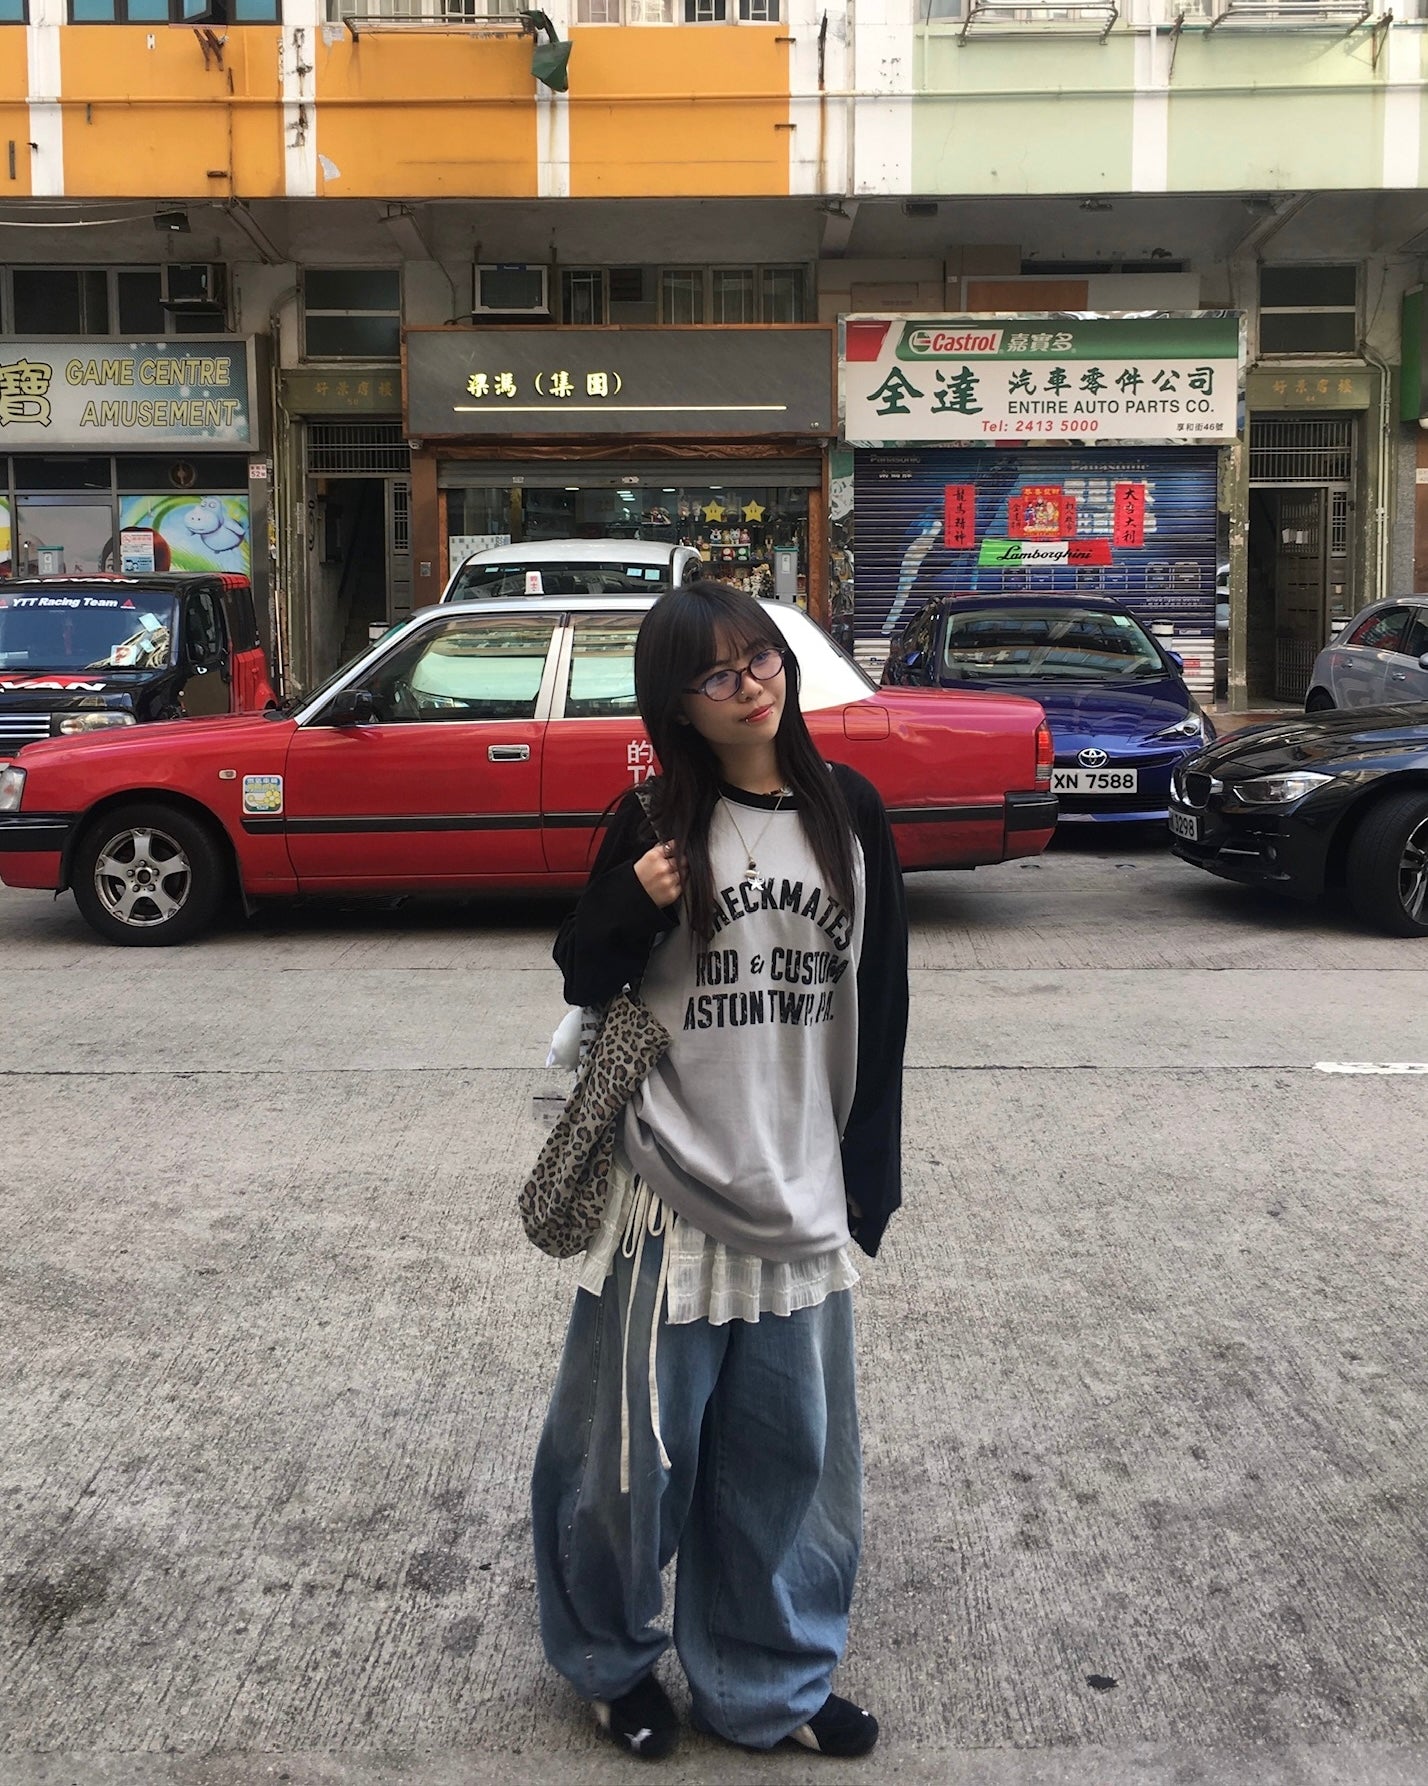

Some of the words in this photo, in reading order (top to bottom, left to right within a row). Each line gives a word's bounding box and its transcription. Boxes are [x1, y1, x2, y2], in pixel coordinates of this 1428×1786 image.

[932, 333, 996, 352] Castrol
[65, 358, 135, 386] GAME
[139, 358, 231, 386] CENTRE
[1008, 366, 1214, 397] 汽車零件公司
[866, 366, 984, 416] 全達
[80, 400, 239, 427] AMUSEMENT
[1008, 401, 1068, 414] ENTIRE
[1073, 400, 1120, 414] AUTO
[1125, 400, 1181, 414] PARTS
[1185, 400, 1215, 413] CO.
[982, 420, 1008, 432] Tel:
[1015, 420, 1054, 432] 2413
[1060, 420, 1099, 432] 5000
[997, 545, 1093, 561] Lamborghini
[12, 598, 38, 608] YTT
[38, 598, 81, 608] Racing
[83, 598, 119, 608] Team
[627, 740, 654, 764] 的
[1054, 774, 1078, 789] XN
[1086, 774, 1134, 789] 7588
[696, 949, 739, 987] ROD
[750, 954, 765, 975] &
[770, 946, 850, 985] CUSTOM
[683, 990, 764, 1030] ASTON
